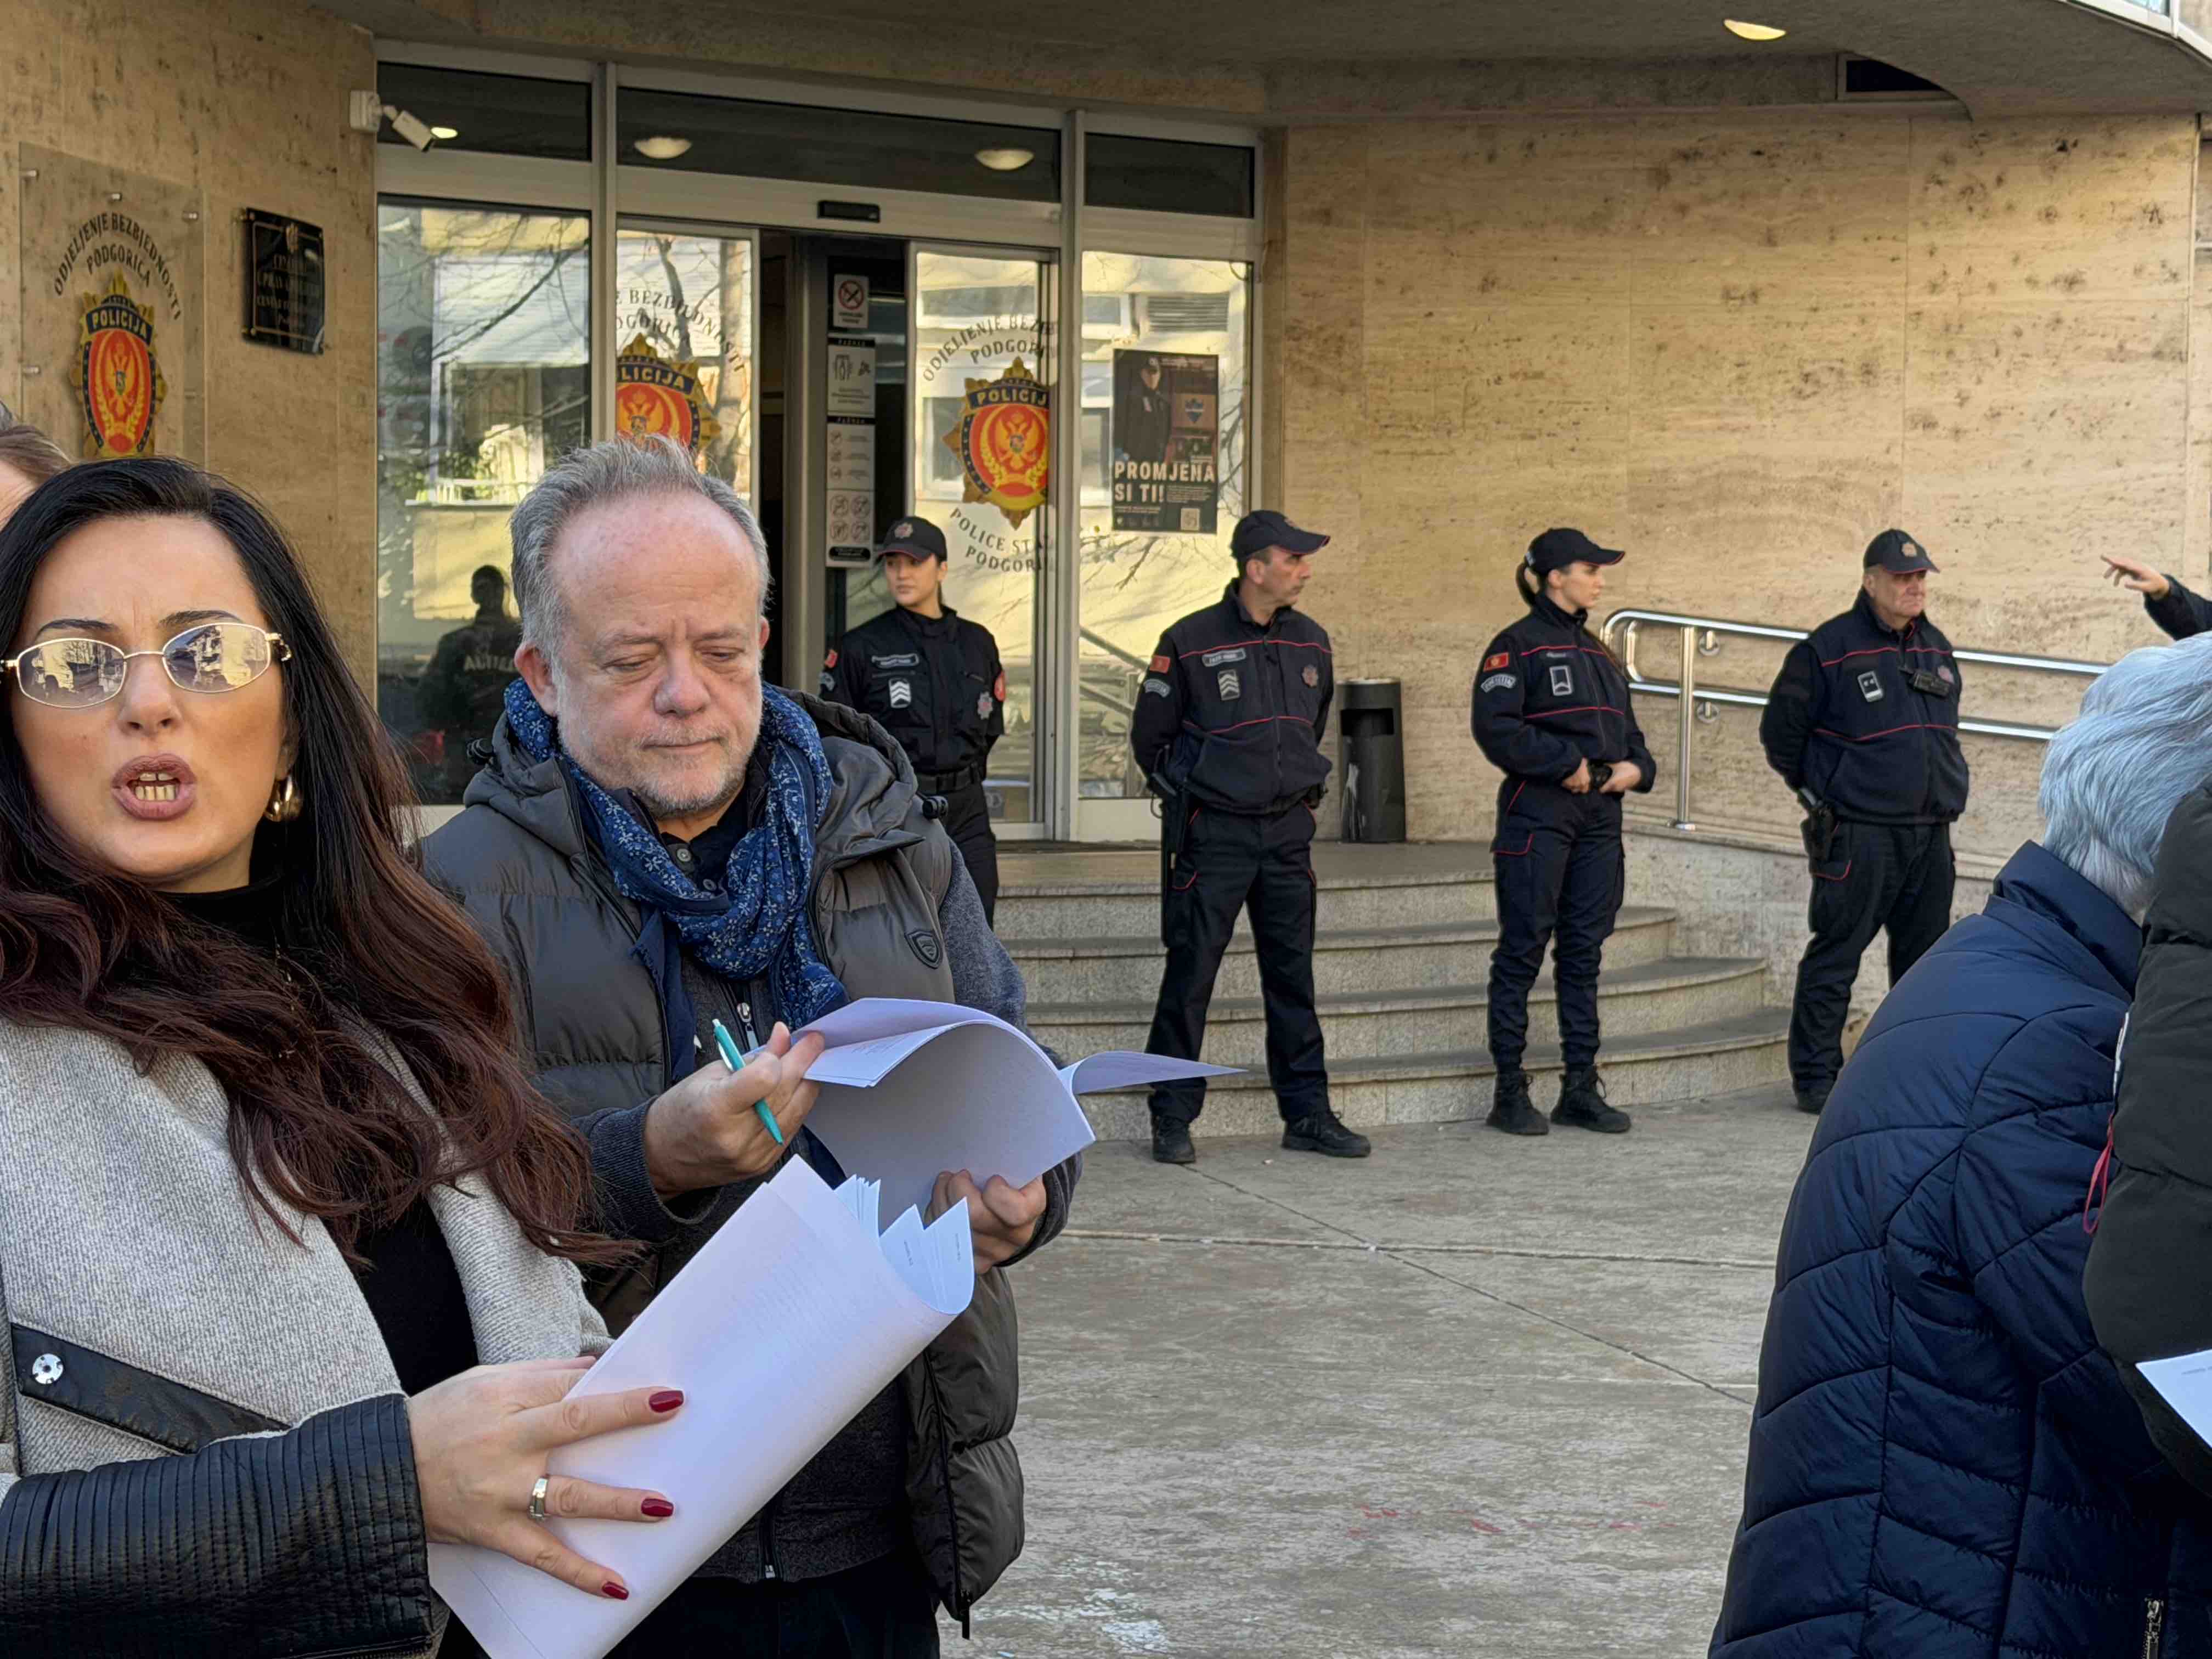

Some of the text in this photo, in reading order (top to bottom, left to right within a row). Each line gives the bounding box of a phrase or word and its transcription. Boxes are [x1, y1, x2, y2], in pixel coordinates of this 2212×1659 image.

[54, 212, 181, 320] ODJELJENJE BEZBJEDNOSTI
[86, 244, 151, 288] PODGORICA
[92, 309, 148, 336] POLICIJA
[923, 315, 1002, 382] ODJELJENJE
[621, 366, 685, 389] LICIJA
[977, 388, 1047, 406] POLICIJ
[1114, 460, 1215, 483] PROMJENA
[1114, 483, 1133, 502] SI
[1139, 484, 1165, 503] TI!
[950, 507, 1006, 551] POLICE
